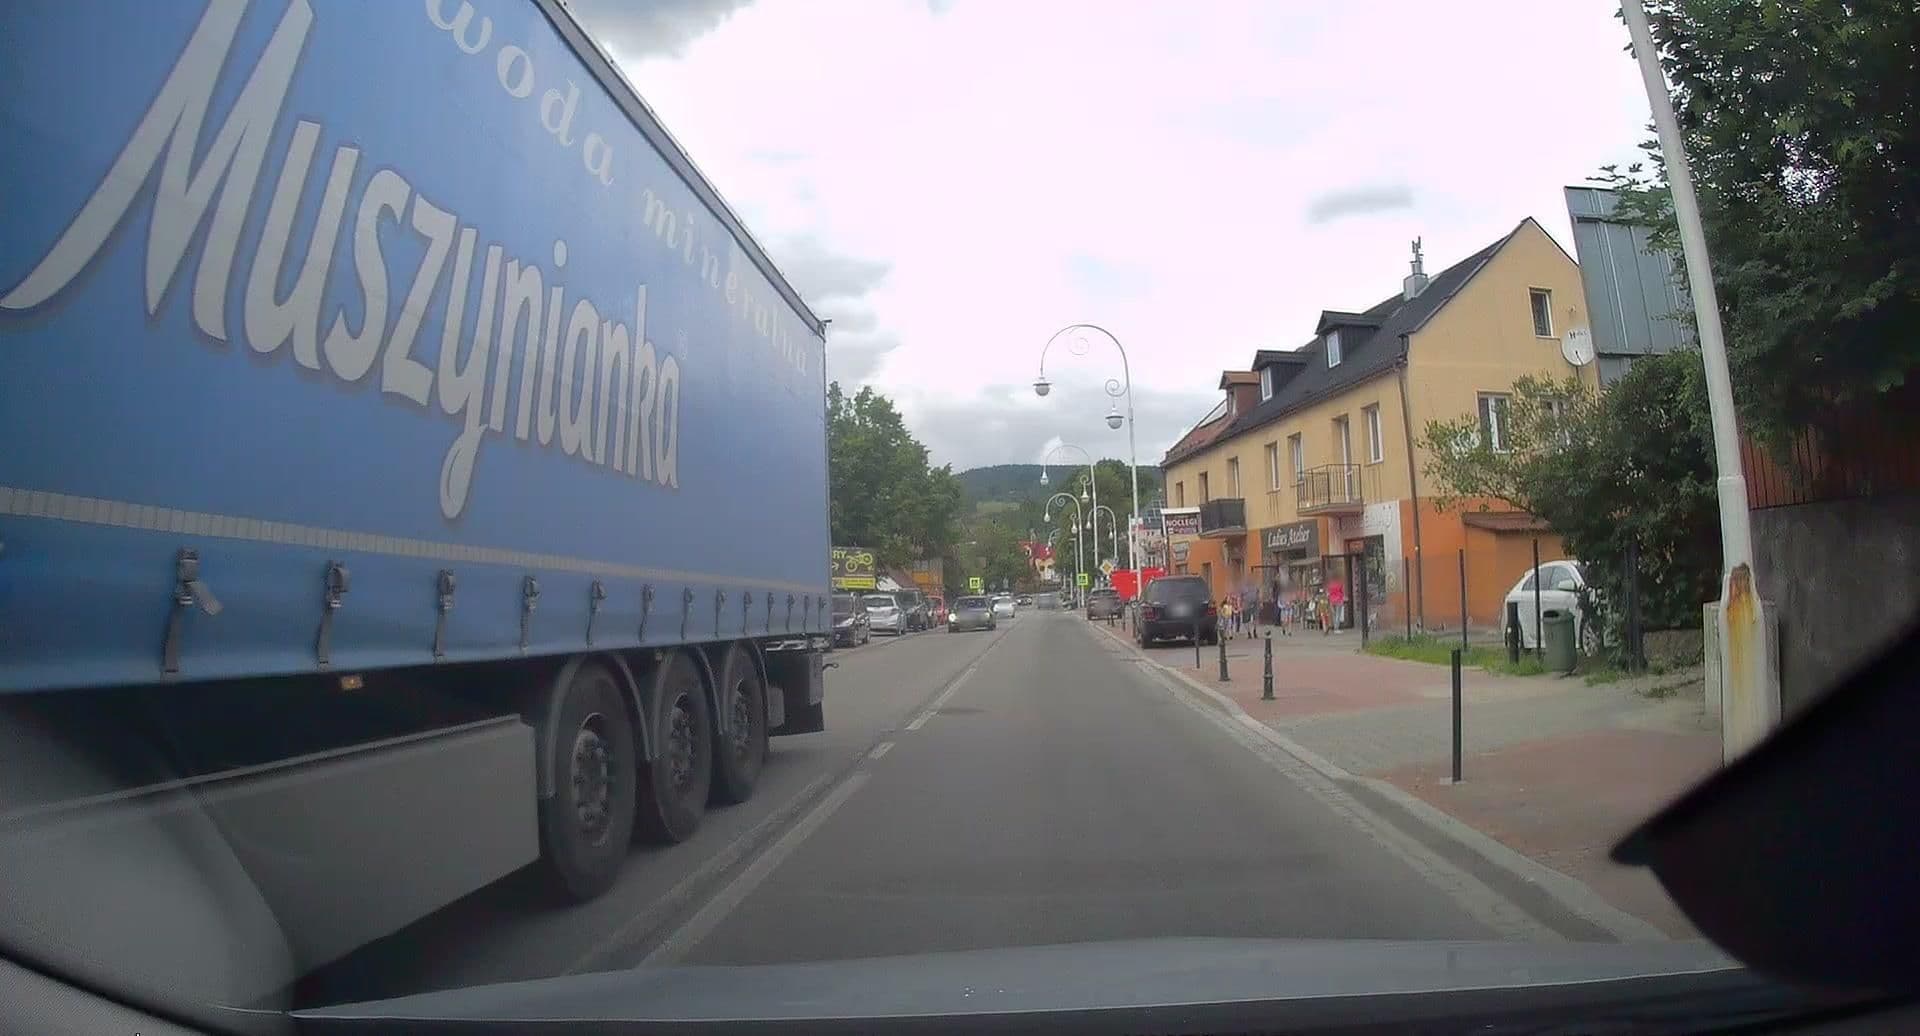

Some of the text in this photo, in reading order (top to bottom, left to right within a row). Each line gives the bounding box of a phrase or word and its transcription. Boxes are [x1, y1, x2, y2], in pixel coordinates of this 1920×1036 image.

[1, 0, 682, 519] Muszynianka
[425, 0, 808, 377] woda mineralna
[1166, 518, 1198, 527] NOCLEGI
